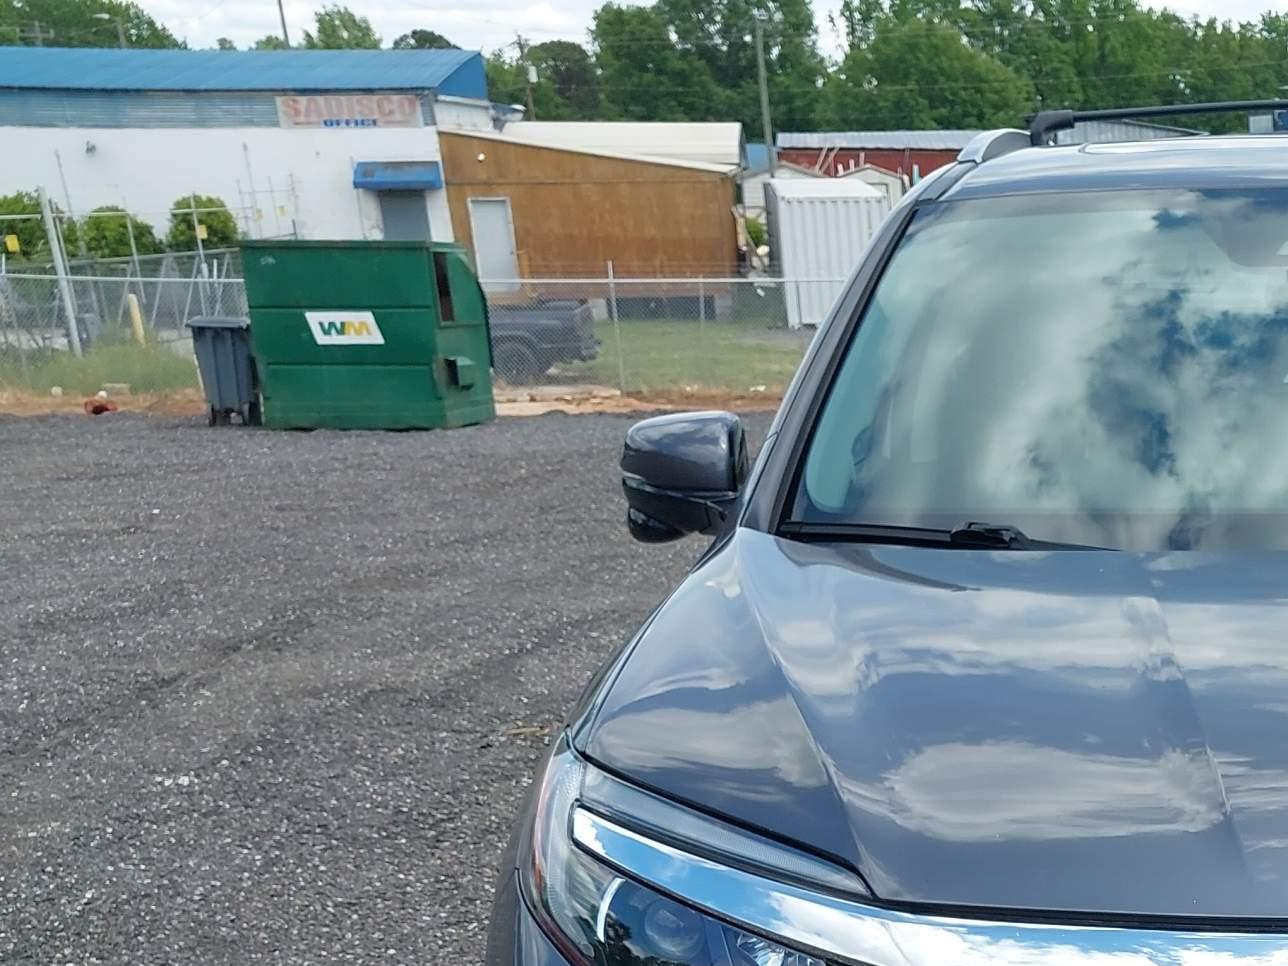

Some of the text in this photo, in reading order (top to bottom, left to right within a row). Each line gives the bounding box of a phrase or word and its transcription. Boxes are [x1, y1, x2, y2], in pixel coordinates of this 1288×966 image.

[280, 95, 418, 118] SADISCO
[322, 118, 378, 128] OFFICE
[318, 321, 371, 336] WM
